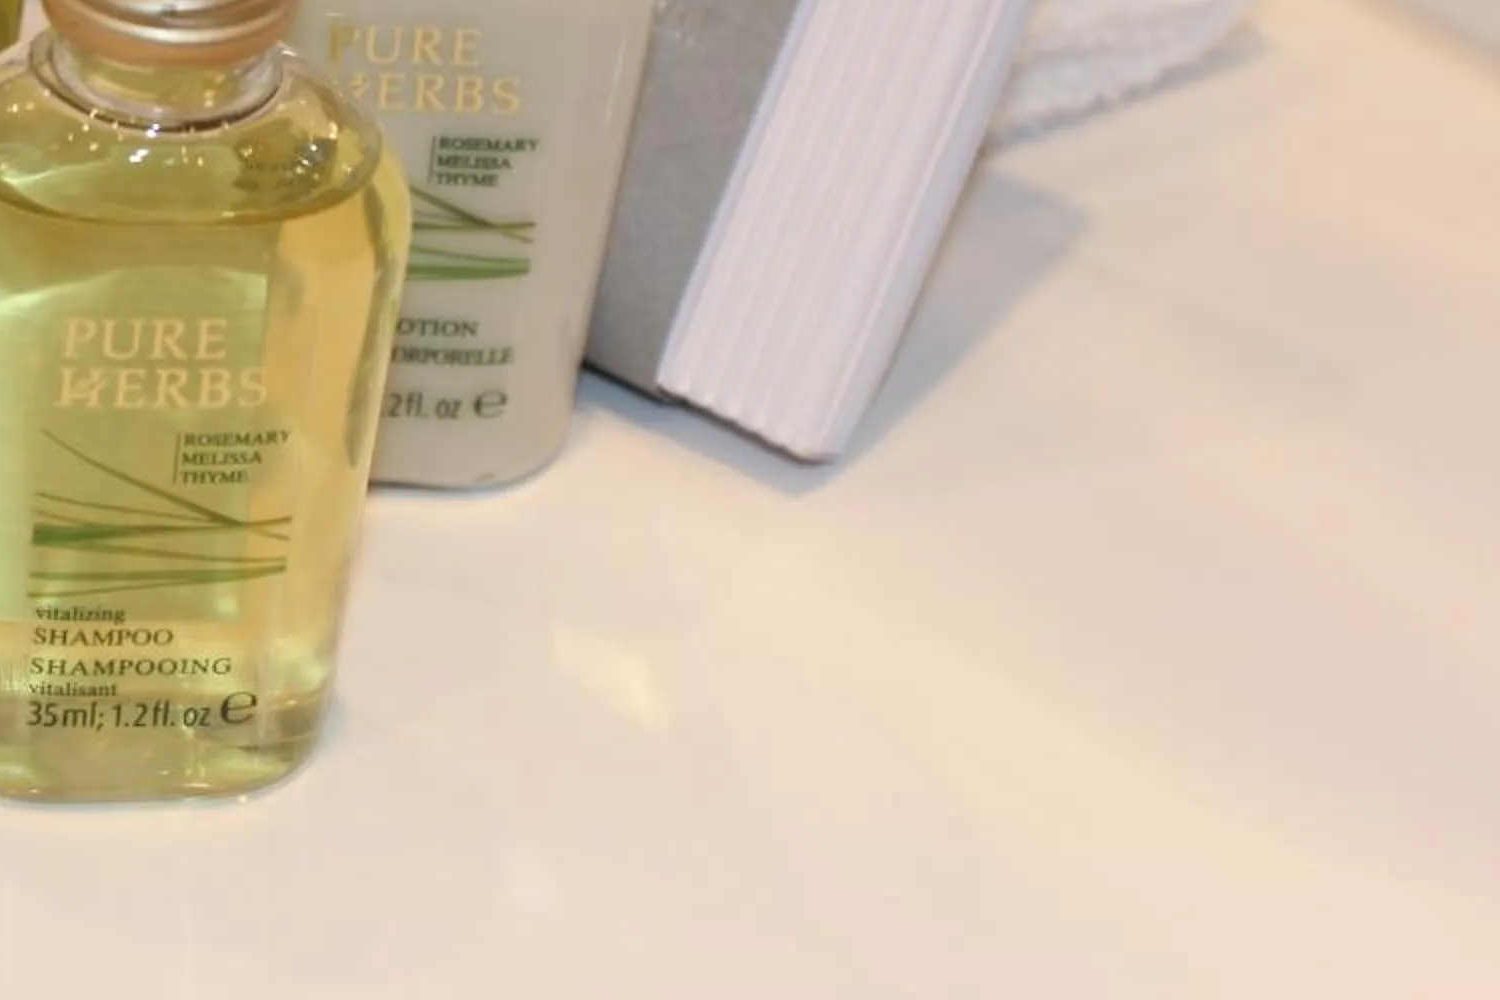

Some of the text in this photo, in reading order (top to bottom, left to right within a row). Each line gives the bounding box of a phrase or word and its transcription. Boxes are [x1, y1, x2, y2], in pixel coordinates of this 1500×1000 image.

[327, 20, 483, 67] PURE
[439, 135, 541, 152] ROSEMARY
[436, 154, 512, 170] MELISSA
[436, 172, 498, 187] THYME
[396, 317, 481, 338] OTION
[62, 316, 228, 361] PURE
[391, 346, 516, 367] ORPORELLE
[54, 365, 268, 411] HERBS
[183, 430, 293, 448] ROSEMARY
[181, 451, 263, 467] MELISSA
[179, 470, 249, 486] THYME
[35, 605, 127, 624] vitalizing
[33, 627, 175, 648] SHAMPOO
[30, 657, 232, 677] SHAMPOOING
[28, 682, 118, 698] vitalisant
[183, 706, 211, 728] oz
